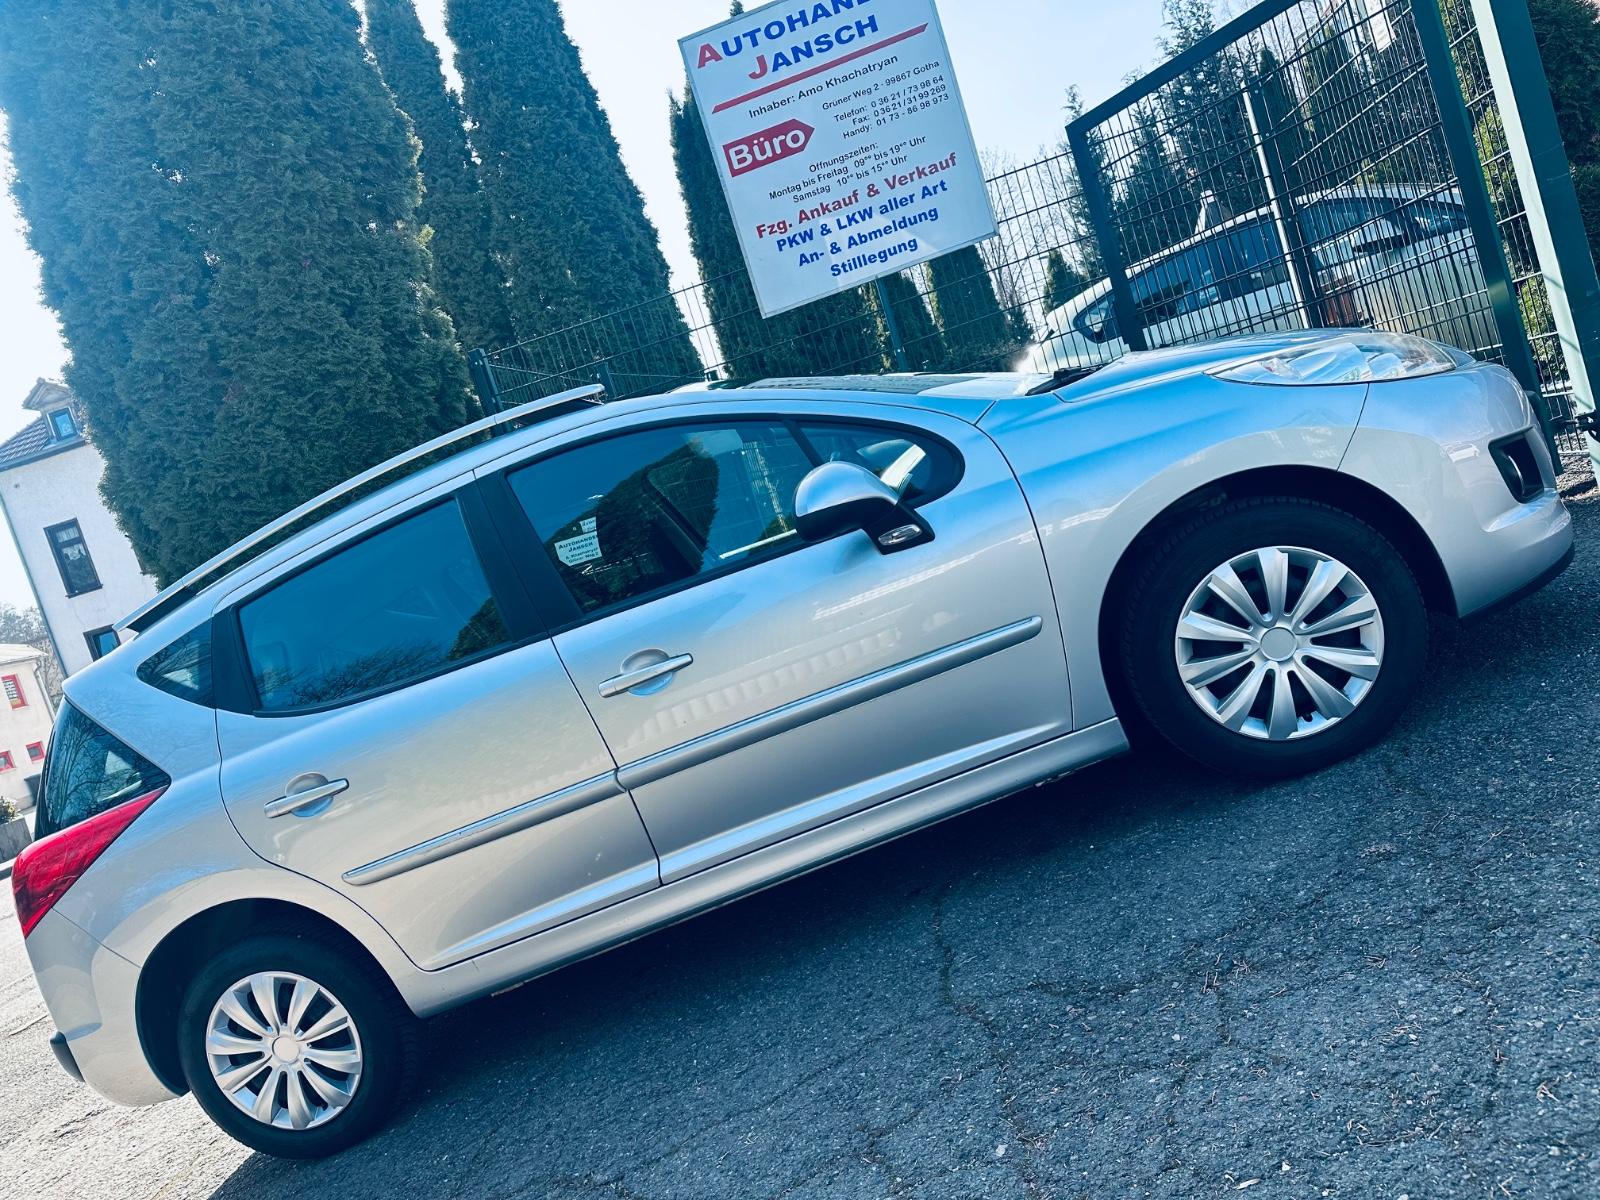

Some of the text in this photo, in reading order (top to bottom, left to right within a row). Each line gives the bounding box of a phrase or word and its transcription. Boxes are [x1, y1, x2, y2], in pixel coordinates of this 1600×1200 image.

[748, 14, 879, 80] JANSCH
[749, 56, 899, 118] Inhaber: Amo Khachatryan
[853, 88, 873, 98] Weg
[874, 83, 880, 91] 2
[885, 71, 911, 86] 99867
[913, 61, 940, 75] Gotha
[834, 105, 868, 122] Telefon:
[843, 124, 873, 139] Handy:
[852, 115, 871, 125] Fax:
[729, 131, 805, 170] Büro
[769, 184, 802, 199] Montag
[802, 178, 817, 188] bis
[817, 163, 849, 182] Freitag
[874, 151, 889, 161] bis
[909, 136, 926, 146] Uhr
[756, 152, 957, 239] Fzg. Ankauf & Verkauf
[793, 184, 831, 203] Samstag
[856, 169, 870, 180] bis
[891, 155, 908, 166] Uhr
[776, 180, 948, 253] PKW & LKW aller Art
[799, 208, 939, 268] An- & Abmeldung
[831, 238, 919, 277] Stilllegung
